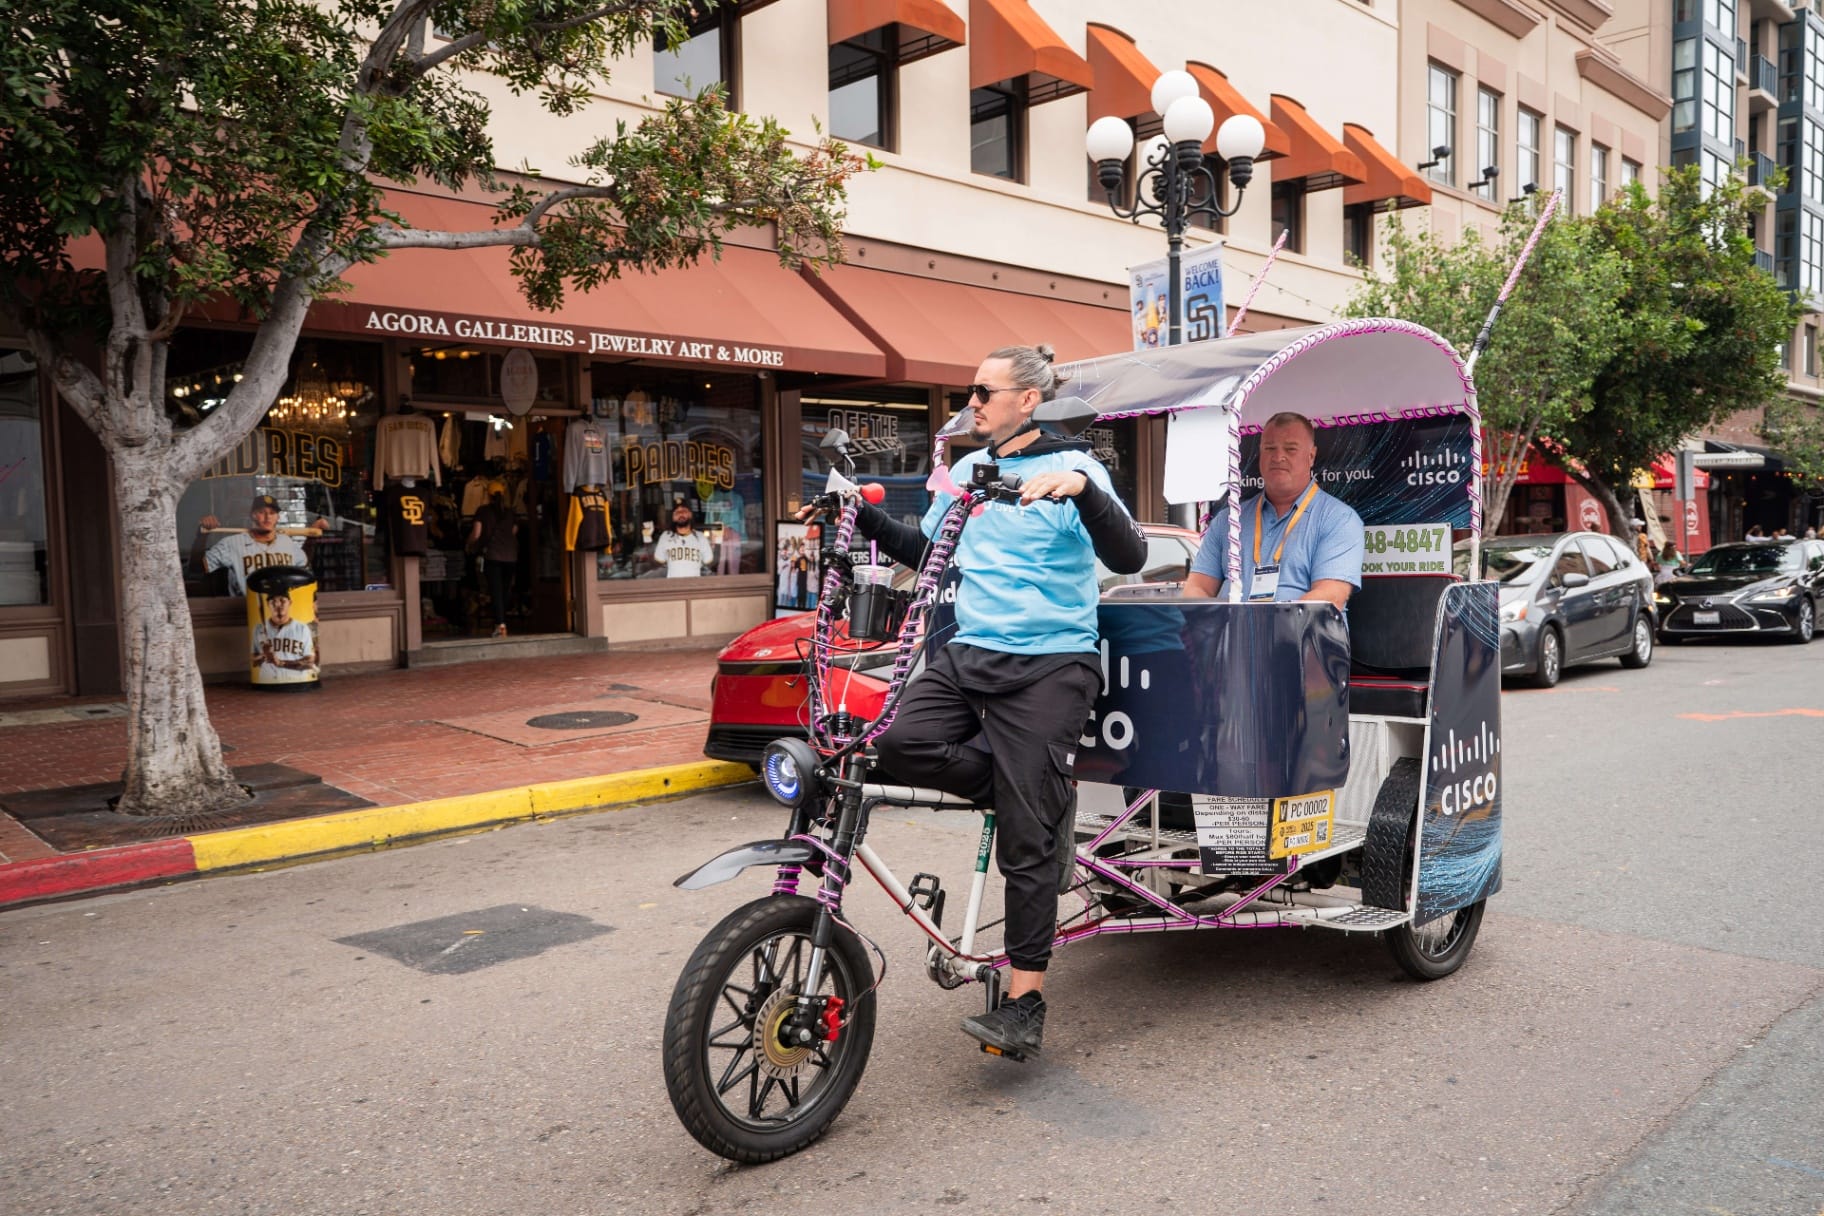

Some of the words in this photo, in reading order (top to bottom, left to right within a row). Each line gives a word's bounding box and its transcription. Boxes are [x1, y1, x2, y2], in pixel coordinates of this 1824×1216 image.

[1185, 260, 1219, 275] WELCOME
[1185, 270, 1219, 291] BACK!
[365, 311, 450, 336] AGORA
[455, 319, 575, 346] GALLERIES
[588, 332, 675, 356] JEWELRY
[678, 341, 714, 360] ART
[717, 346, 730, 361] &
[734, 347, 784, 366] MORE
[870, 413, 898, 440] THE
[201, 427, 342, 488] DRES
[626, 440, 735, 490] PADRES
[1240, 475, 1264, 488] king
[1322, 469, 1341, 482] for
[1345, 469, 1375, 483] you.
[1407, 470, 1460, 486] CISCO
[1364, 528, 1445, 553] 48-4847
[1361, 562, 1383, 572] OOK
[1386, 561, 1416, 572] YOUR
[1419, 560, 1445, 571] RIDE
[1441, 771, 1497, 816] CISCO
[1291, 802, 1302, 818] PC
[1304, 799, 1327, 816] 00002
[979, 827, 991, 857] 2025
